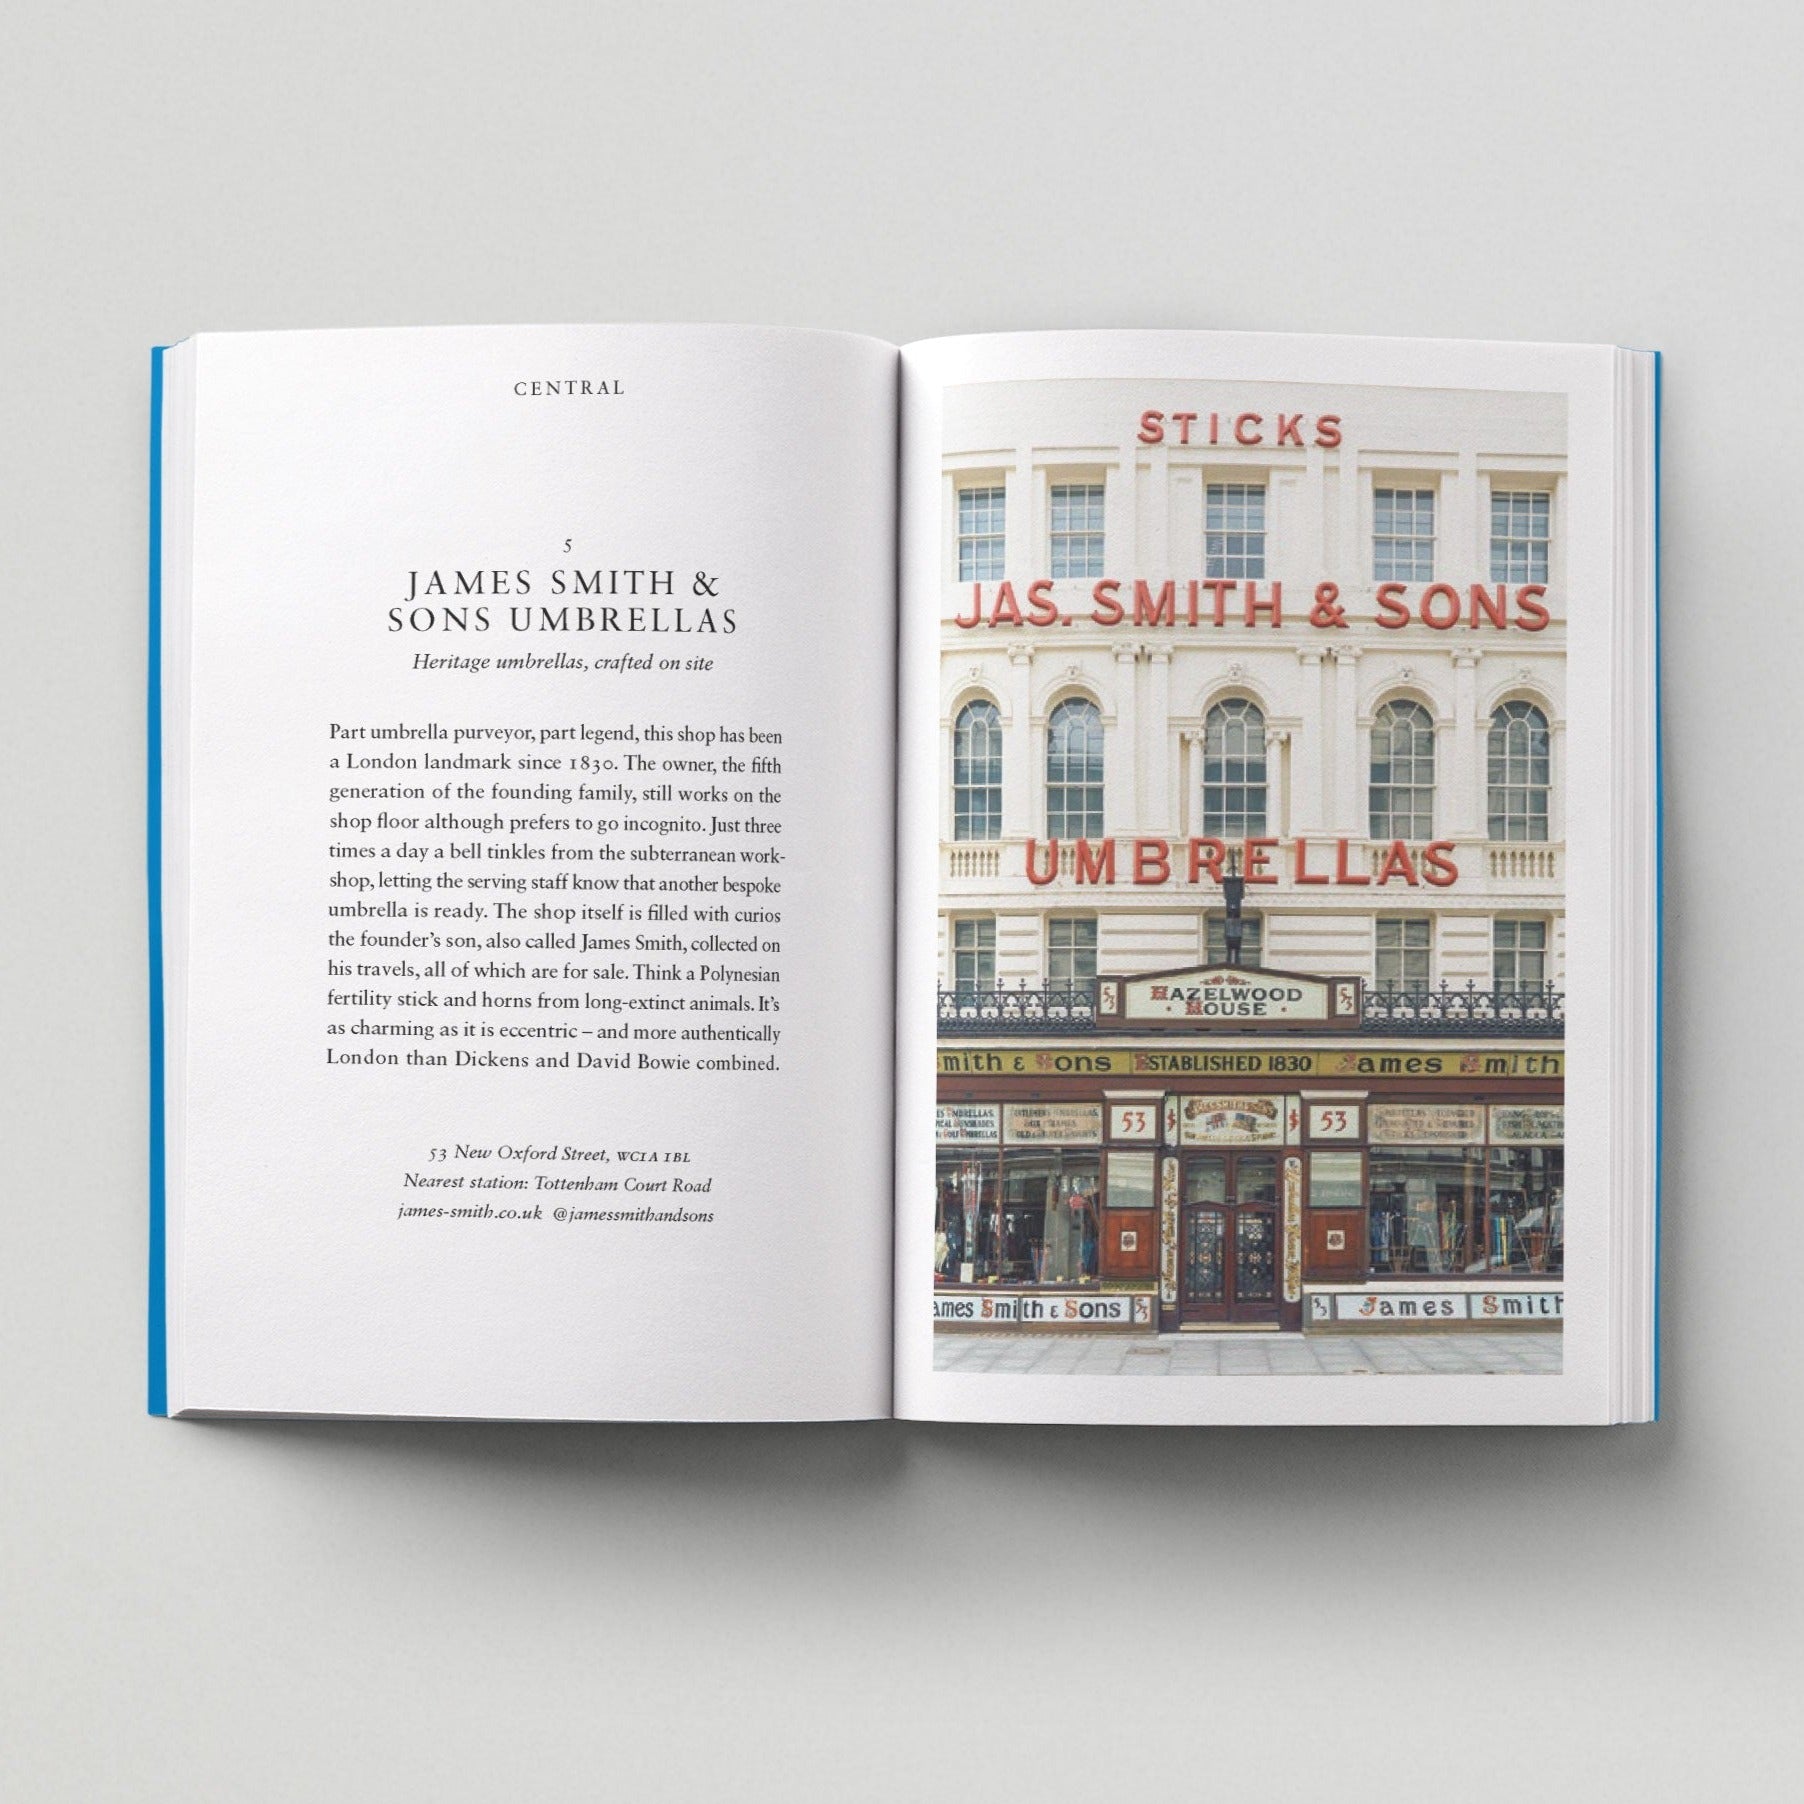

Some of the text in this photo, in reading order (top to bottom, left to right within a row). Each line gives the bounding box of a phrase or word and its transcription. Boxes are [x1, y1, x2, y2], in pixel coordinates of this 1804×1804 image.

[514, 380, 624, 396] CENTRAL
[1139, 412, 1341, 448] STICKS
[563, 539, 572, 553] 5
[404, 570, 719, 601] JAMES SMITH &
[956, 580, 1550, 630] JAS. SMITH & SONS
[388, 607, 736, 634] SONS UMBRELLAS
[412, 652, 714, 673] Heritage umbrellas, crafted on site
[329, 723, 782, 746] Part umbrella purveyor, part legend, this shop has been
[346, 753, 781, 775] London landmark since 1830. The owner, the fifth
[329, 782, 781, 804] generation of the founding family, still works on the
[330, 812, 782, 836] shop floor although prefers to go incognito. Just three
[329, 842, 786, 863] times day bell tinkles from the subterranean work-
[1026, 838, 1458, 887] UMBRELLAS
[330, 871, 781, 897] shop, letting the serving staff know that another bespoke
[328, 901, 781, 924] umbrella is ready. The shop itself is filled with curios
[328, 930, 355, 946] the
[446, 937, 482, 951] son,
[486, 931, 521, 948] also
[525, 932, 576, 949] called
[579, 933, 630, 953] James
[635, 934, 687, 954] Smith,
[691, 935, 757, 952] collected
[762, 941, 781, 952] on
[328, 959, 780, 985] his travels, all of which are for sale. Think Polynesian
[327, 989, 393, 1010] fertility
[397, 990, 439, 1006] stick
[443, 991, 477, 1007] and
[482, 991, 532, 1008] horns
[537, 992, 580, 1008] from
[585, 992, 685, 1013] long-extinct
[689, 995, 754, 1011] animals.
[1150, 986, 1302, 1001] HAZELWOOD
[1186, 1000, 1267, 1015] HOUSE
[327, 1019, 781, 1045] as charming as it is eccentric and more authentically
[326, 1048, 779, 1071] London than Dickens and David Bowie combined.
[1135, 1053, 1312, 1072] ESTABLISHED 1830
[1121, 1111, 1146, 1133] 53
[1320, 1111, 1347, 1132] 53
[428, 1148, 447, 1162] 53
[454, 1144, 492, 1158] New
[497, 1145, 558, 1163] Oxford
[561, 1146, 610, 1163] Street,
[403, 1173, 712, 1192] Nearest station: Tottenham Court Road
[397, 1203, 714, 1224] james-smith.co.uk @jamessmithandsons
[981, 1298, 1121, 1319] Smith Sons
[1359, 1296, 1454, 1316] James
